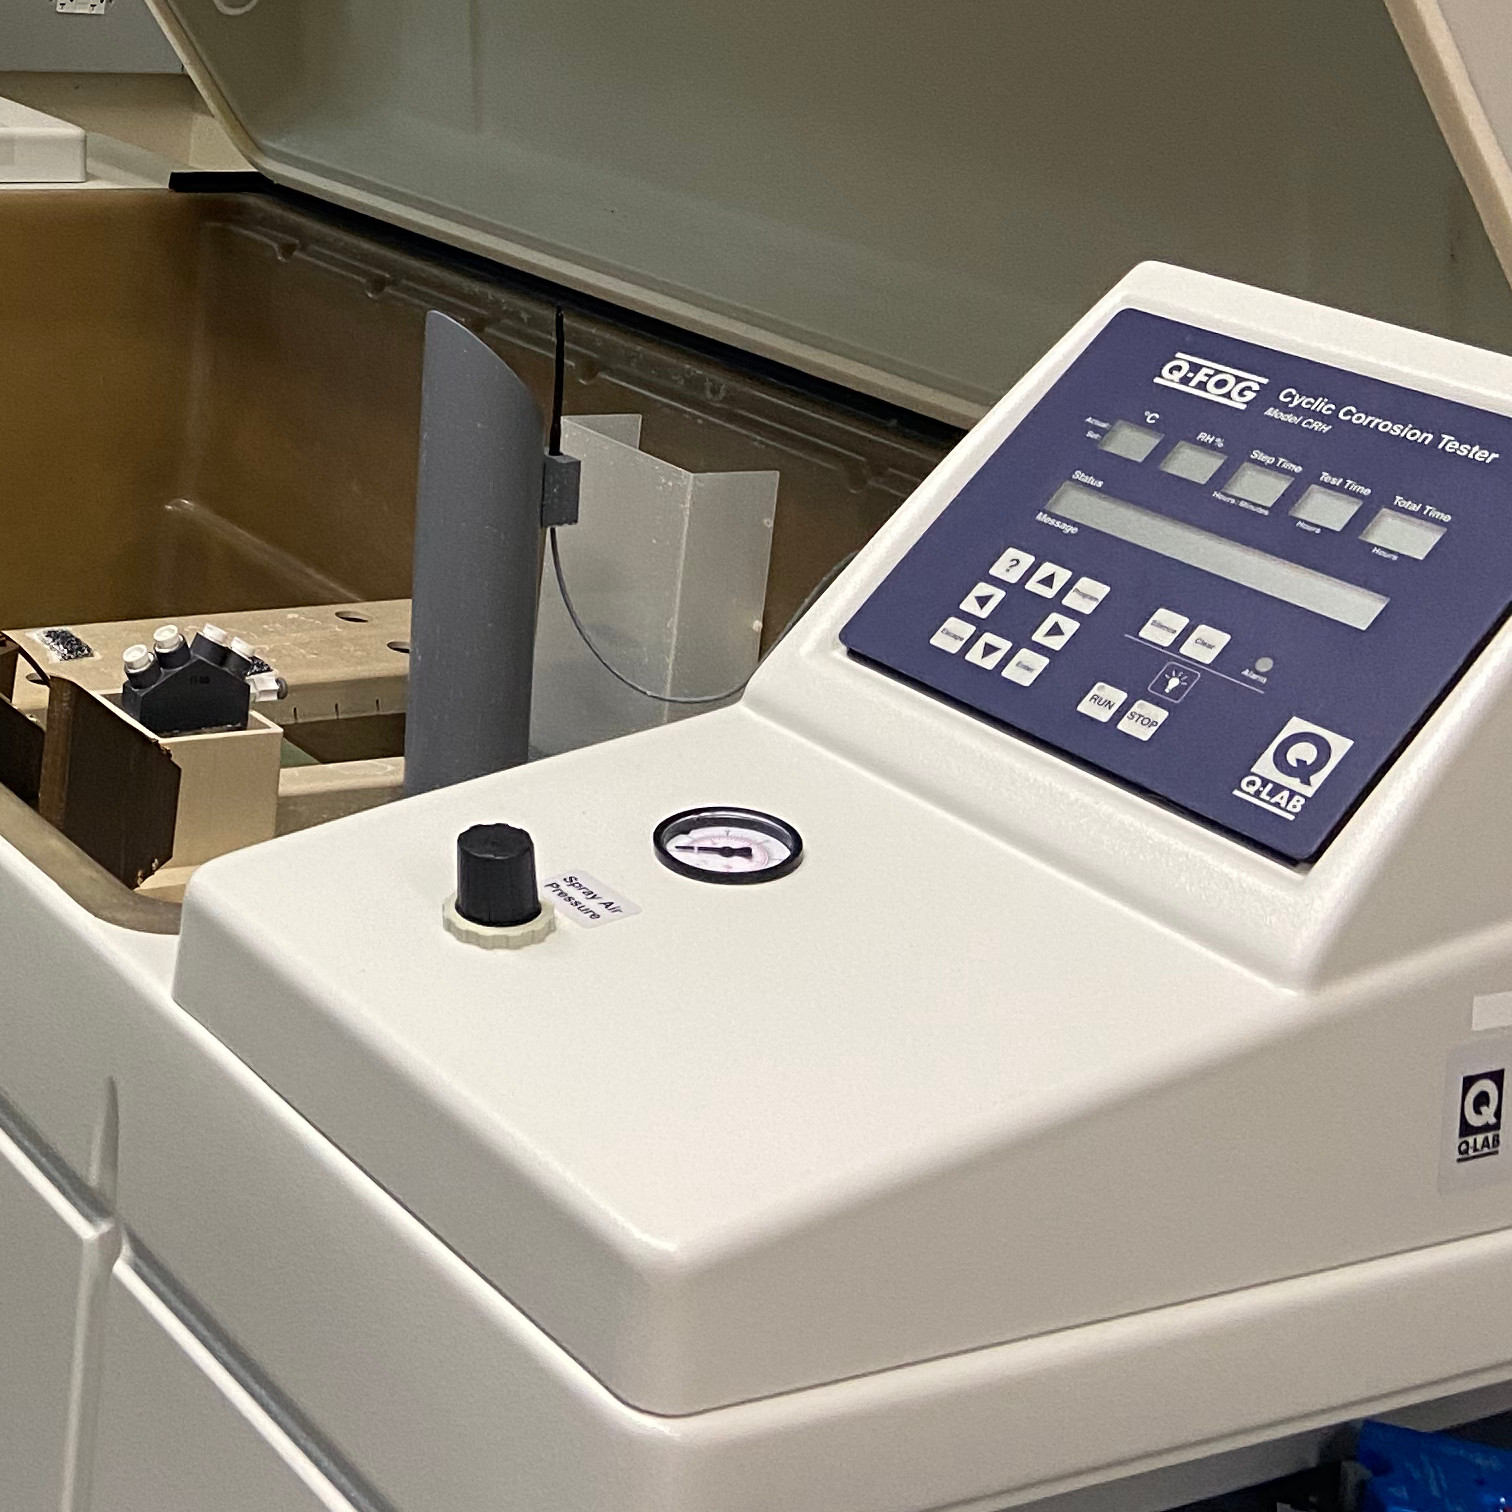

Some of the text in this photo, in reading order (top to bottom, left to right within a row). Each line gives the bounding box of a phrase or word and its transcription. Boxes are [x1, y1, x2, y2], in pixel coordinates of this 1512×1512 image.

[1264, 407, 1333, 434] Model CRH
[1278, 387, 1500, 464] Cyclic Corrosion Tester
[1250, 450, 1303, 473] Step Time
[1072, 470, 1104, 488] Status
[1320, 472, 1372, 496] Test Time
[1393, 496, 1452, 522] Total Time
[1035, 511, 1078, 535] Message
[1372, 546, 1399, 561] Hours
[1195, 638, 1215, 650] Clear
[1089, 694, 1115, 711] RUN
[1127, 711, 1159, 729] STOP
[544, 882, 600, 919] Pressure
[563, 876, 623, 913] Spray Air
[1464, 1078, 1499, 1127] Q
